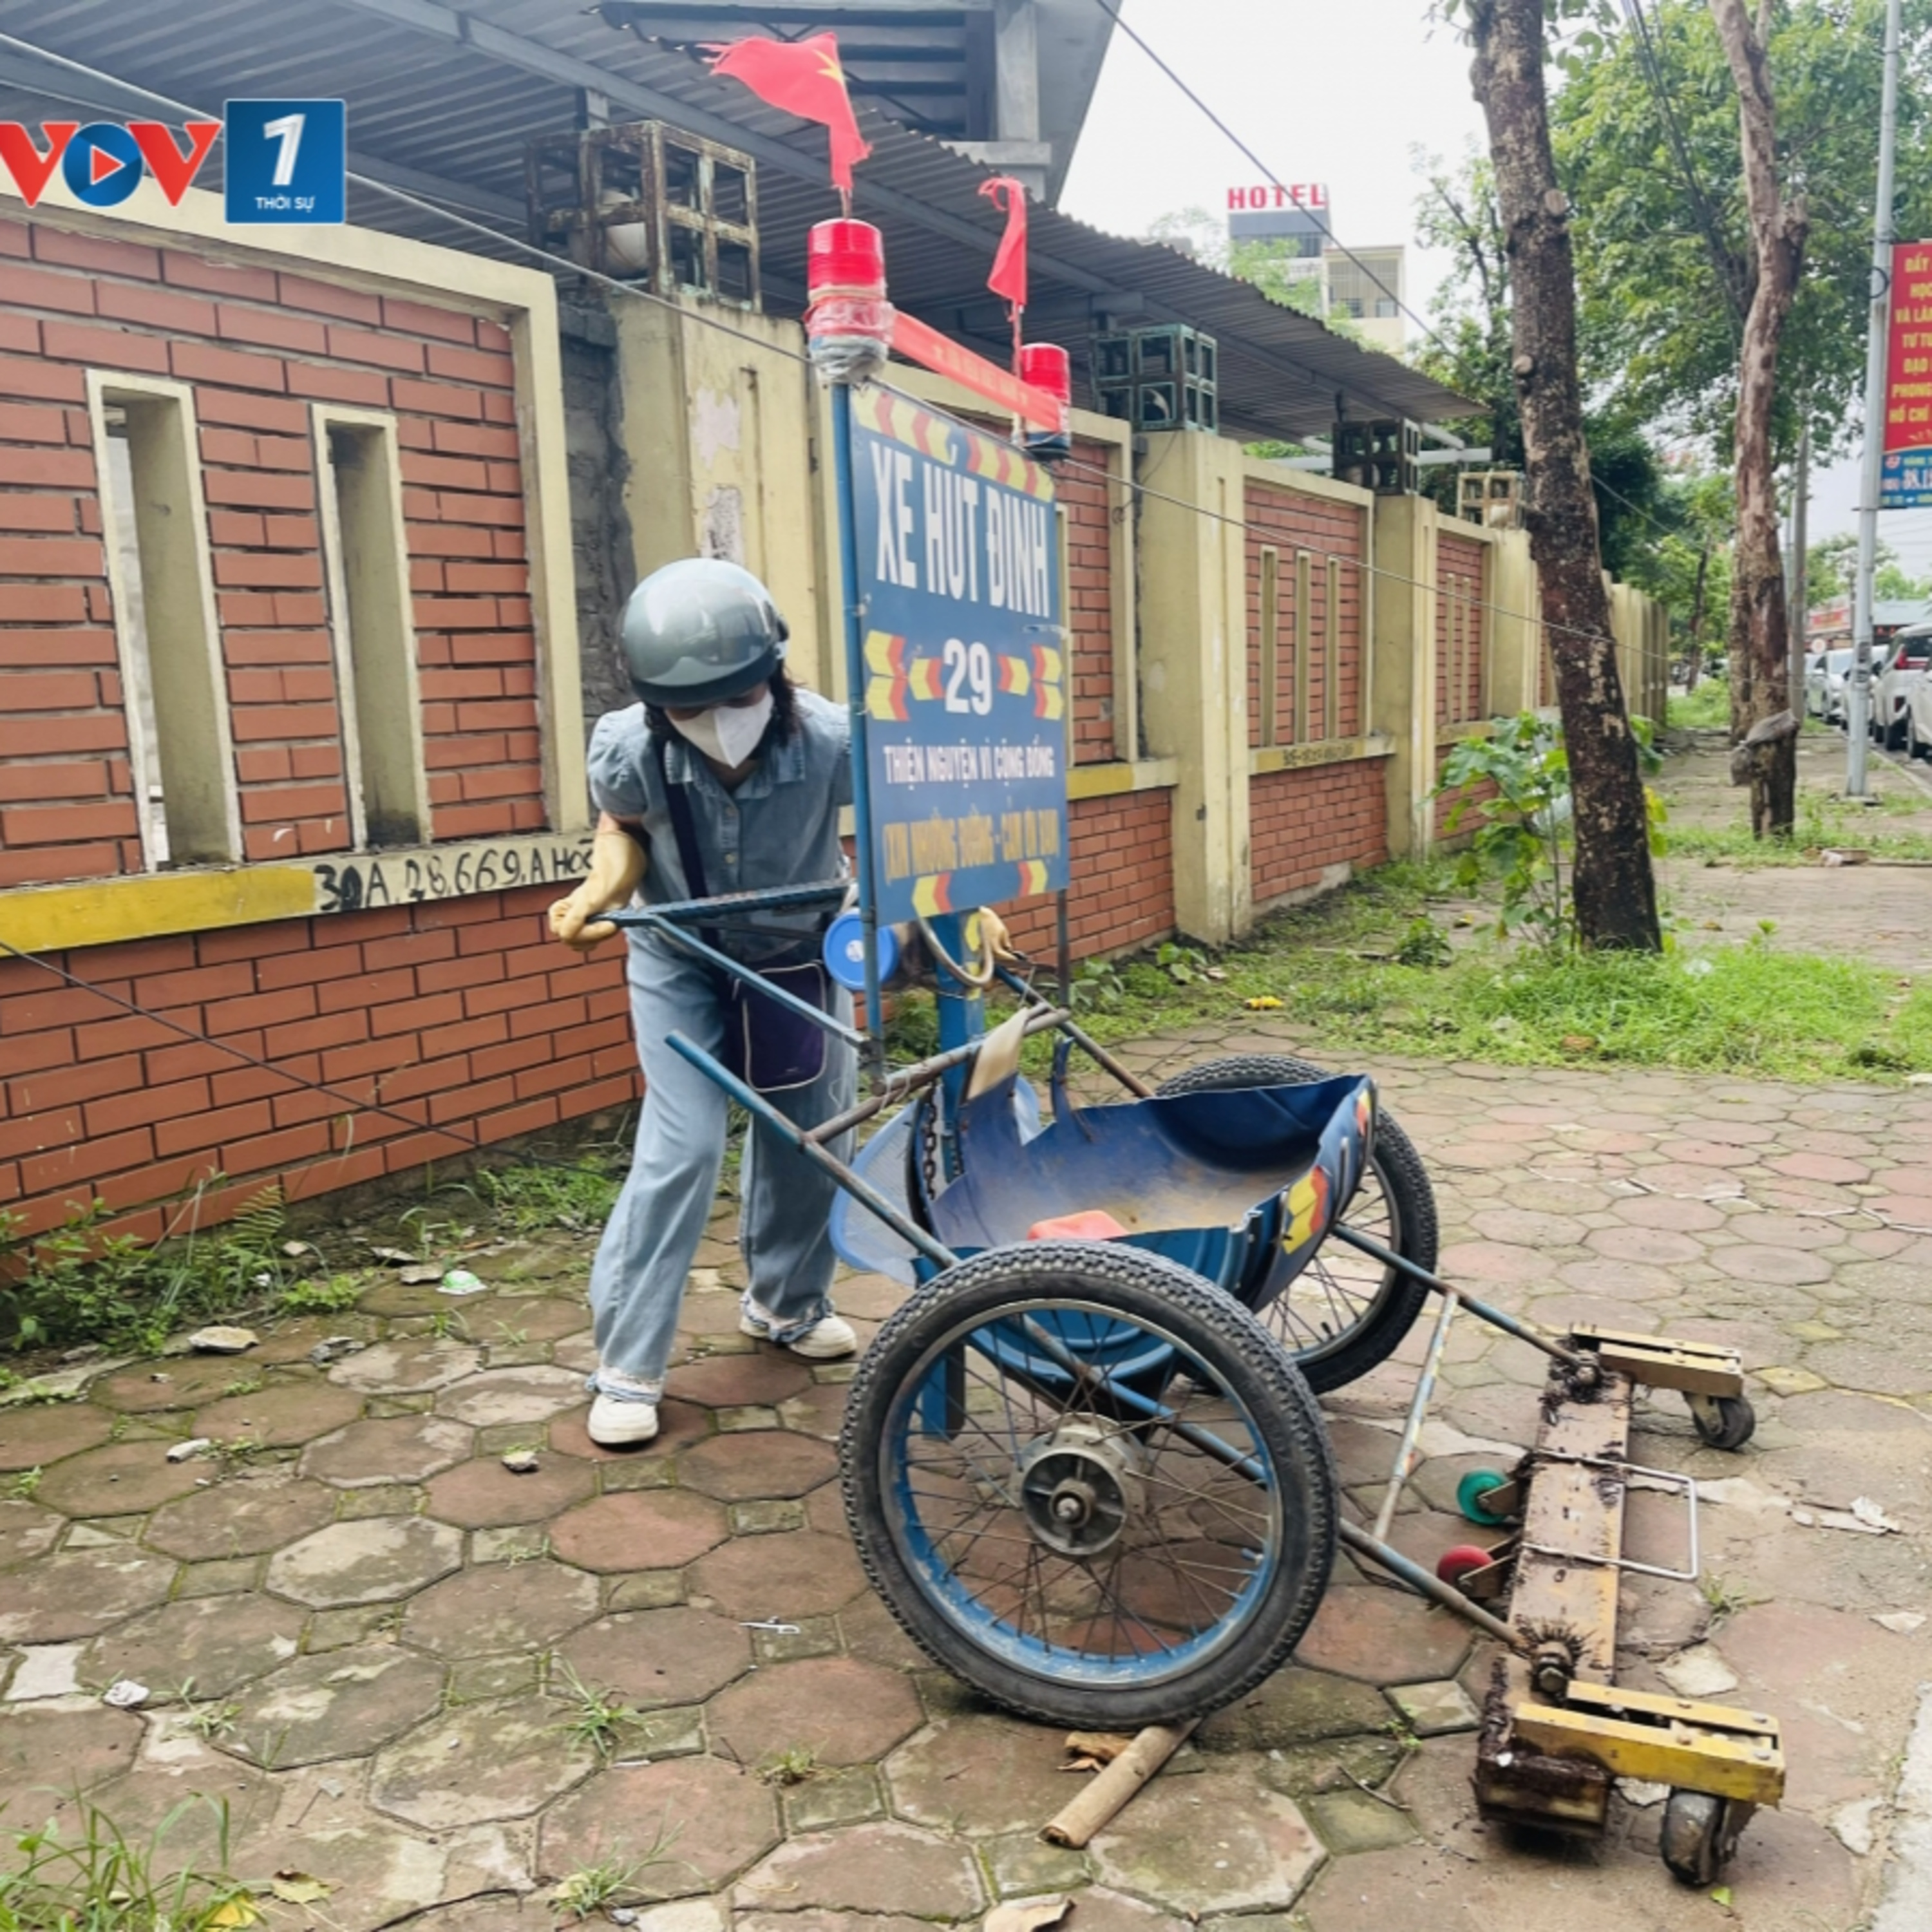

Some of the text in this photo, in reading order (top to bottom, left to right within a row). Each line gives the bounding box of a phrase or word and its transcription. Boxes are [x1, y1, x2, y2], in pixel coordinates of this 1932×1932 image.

[1227, 184, 1327, 209] HOTEL
[870, 440, 917, 589] XE
[986, 485, 1050, 618] ĐINH
[943, 638, 992, 716] 29
